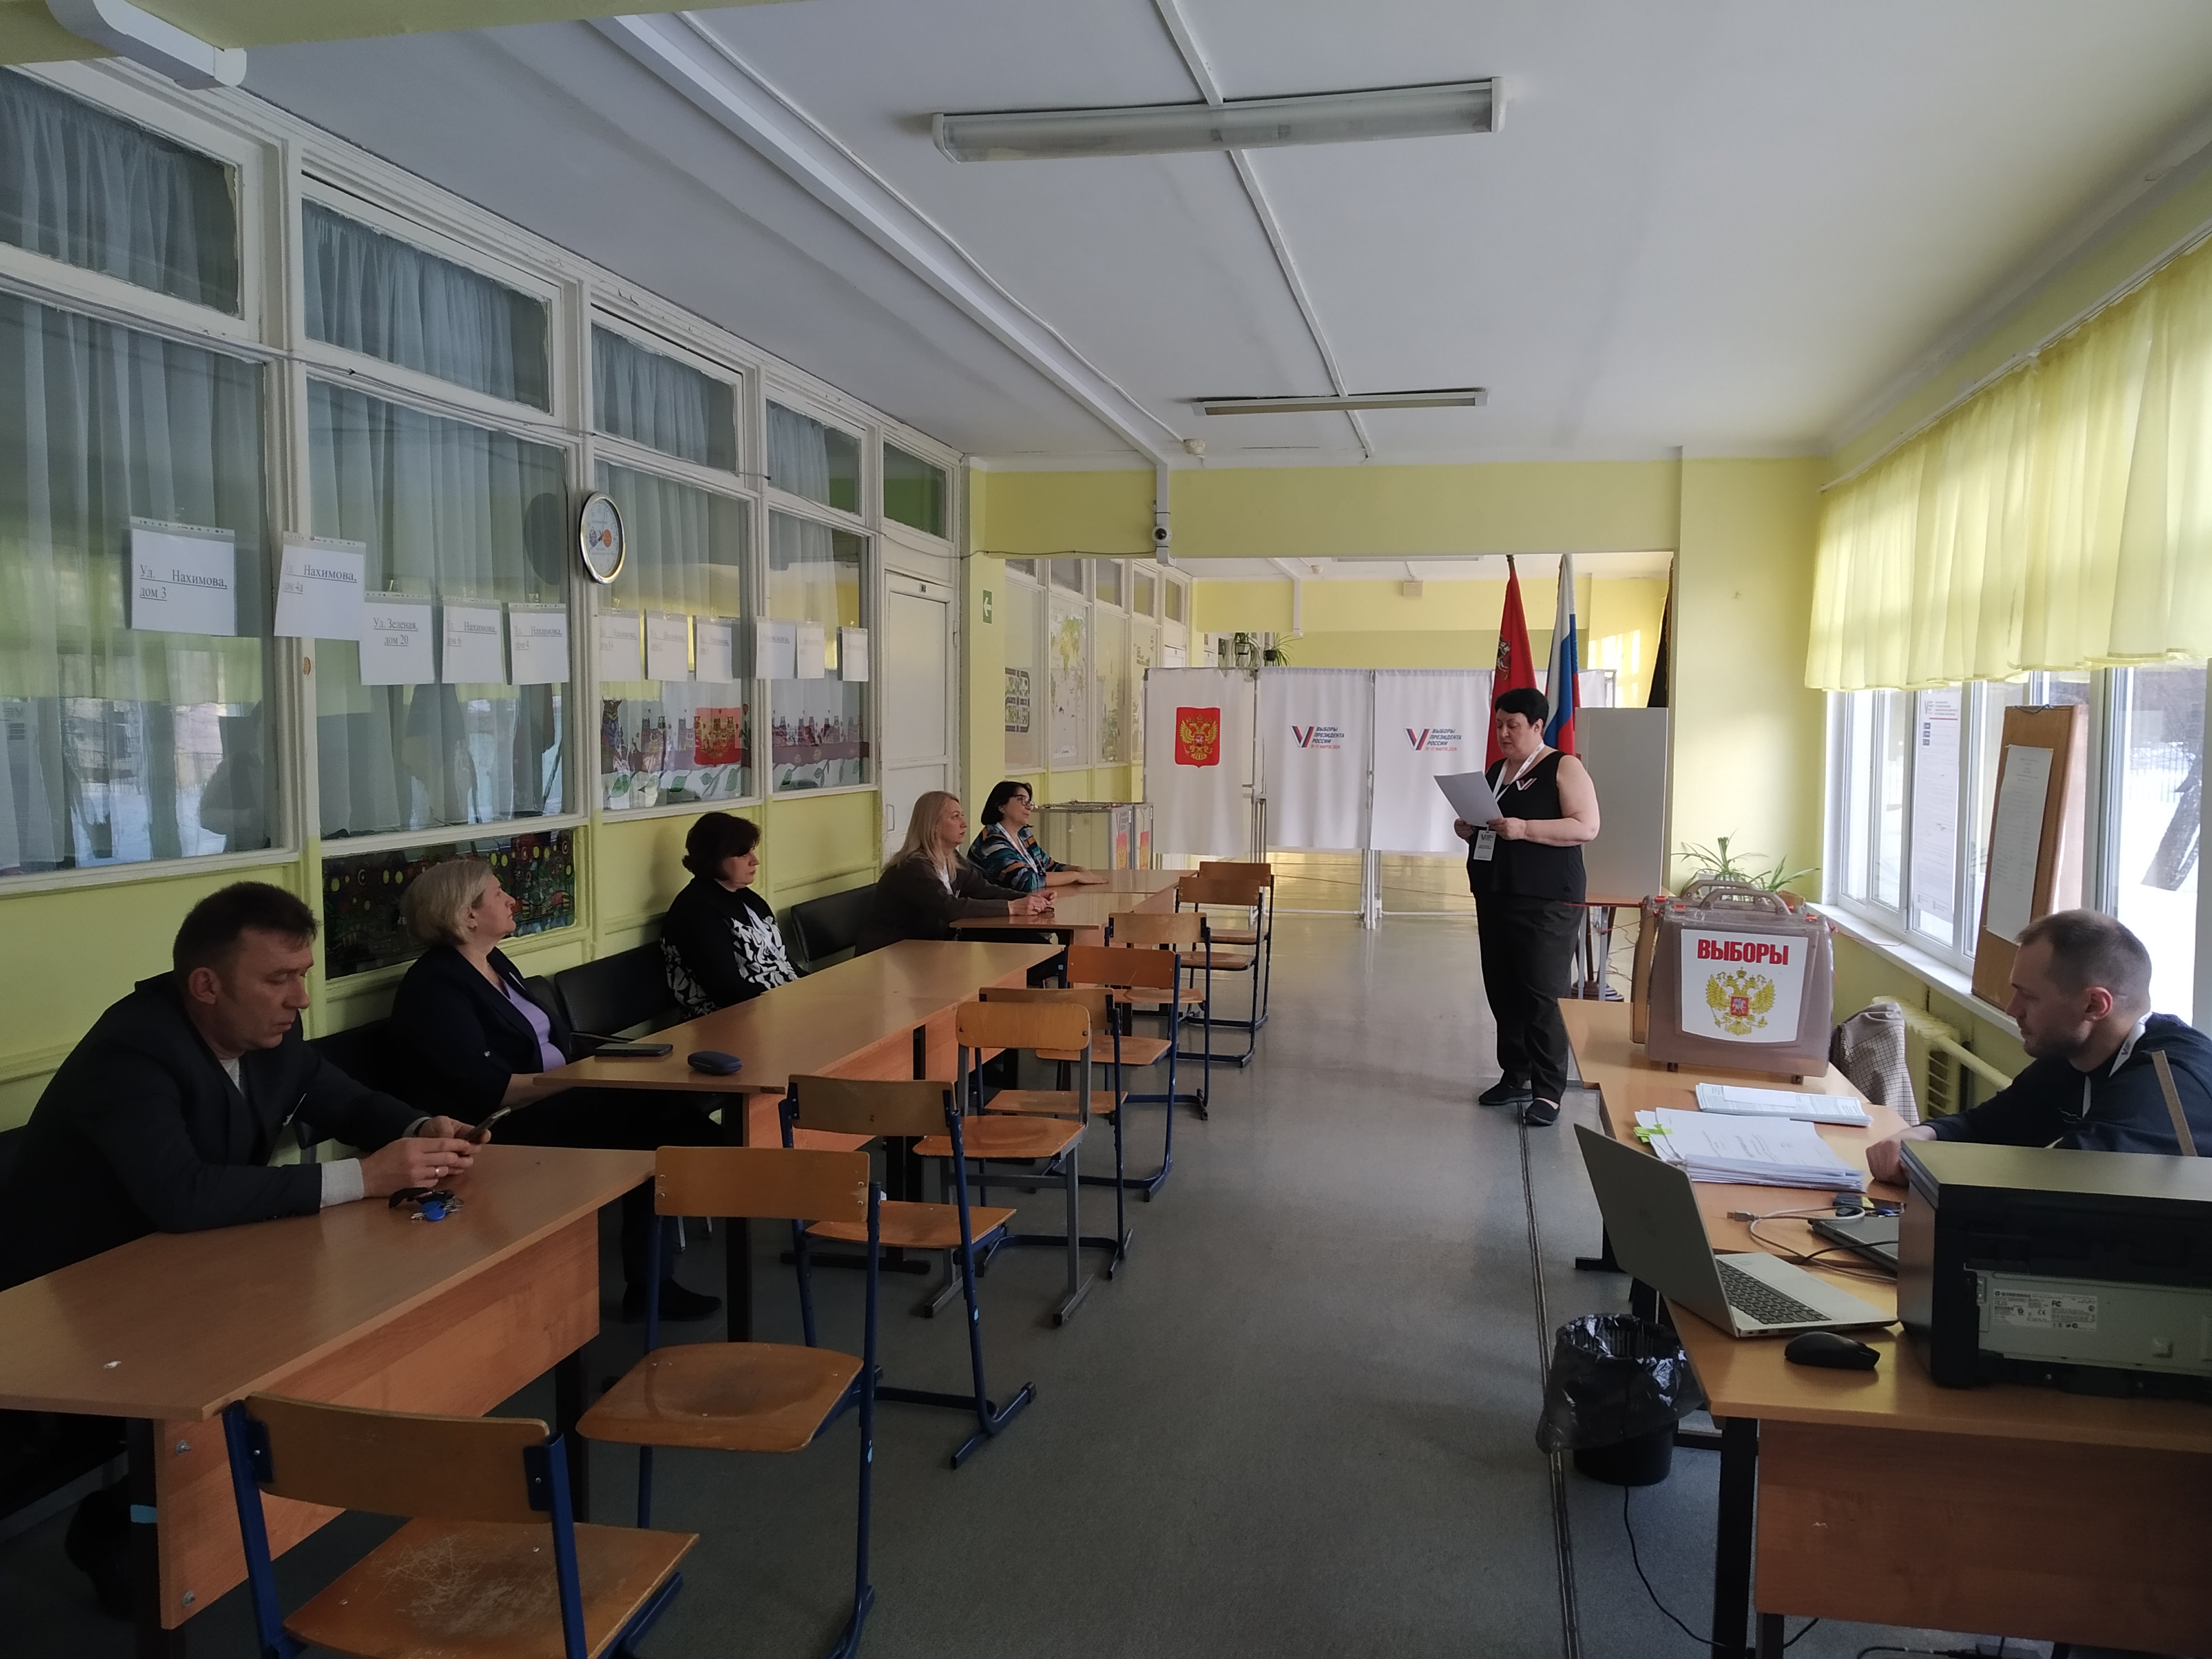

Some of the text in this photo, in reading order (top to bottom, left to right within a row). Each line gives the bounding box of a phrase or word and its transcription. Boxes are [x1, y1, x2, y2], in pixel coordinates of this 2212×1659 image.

[140, 565, 227, 588] Ул. Нахимова,
[304, 565, 357, 581] Нахимова,
[140, 587, 167, 598] дом 3
[373, 618, 418, 630] Ул. Зеленая,
[464, 621, 497, 633] Нахимова,
[531, 626, 562, 635] Нахимова,
[400, 634, 409, 645] 20
[457, 635, 462, 645] 6
[526, 640, 529, 648] 4
[1697, 939, 1789, 966] ВЫБОРЫ
